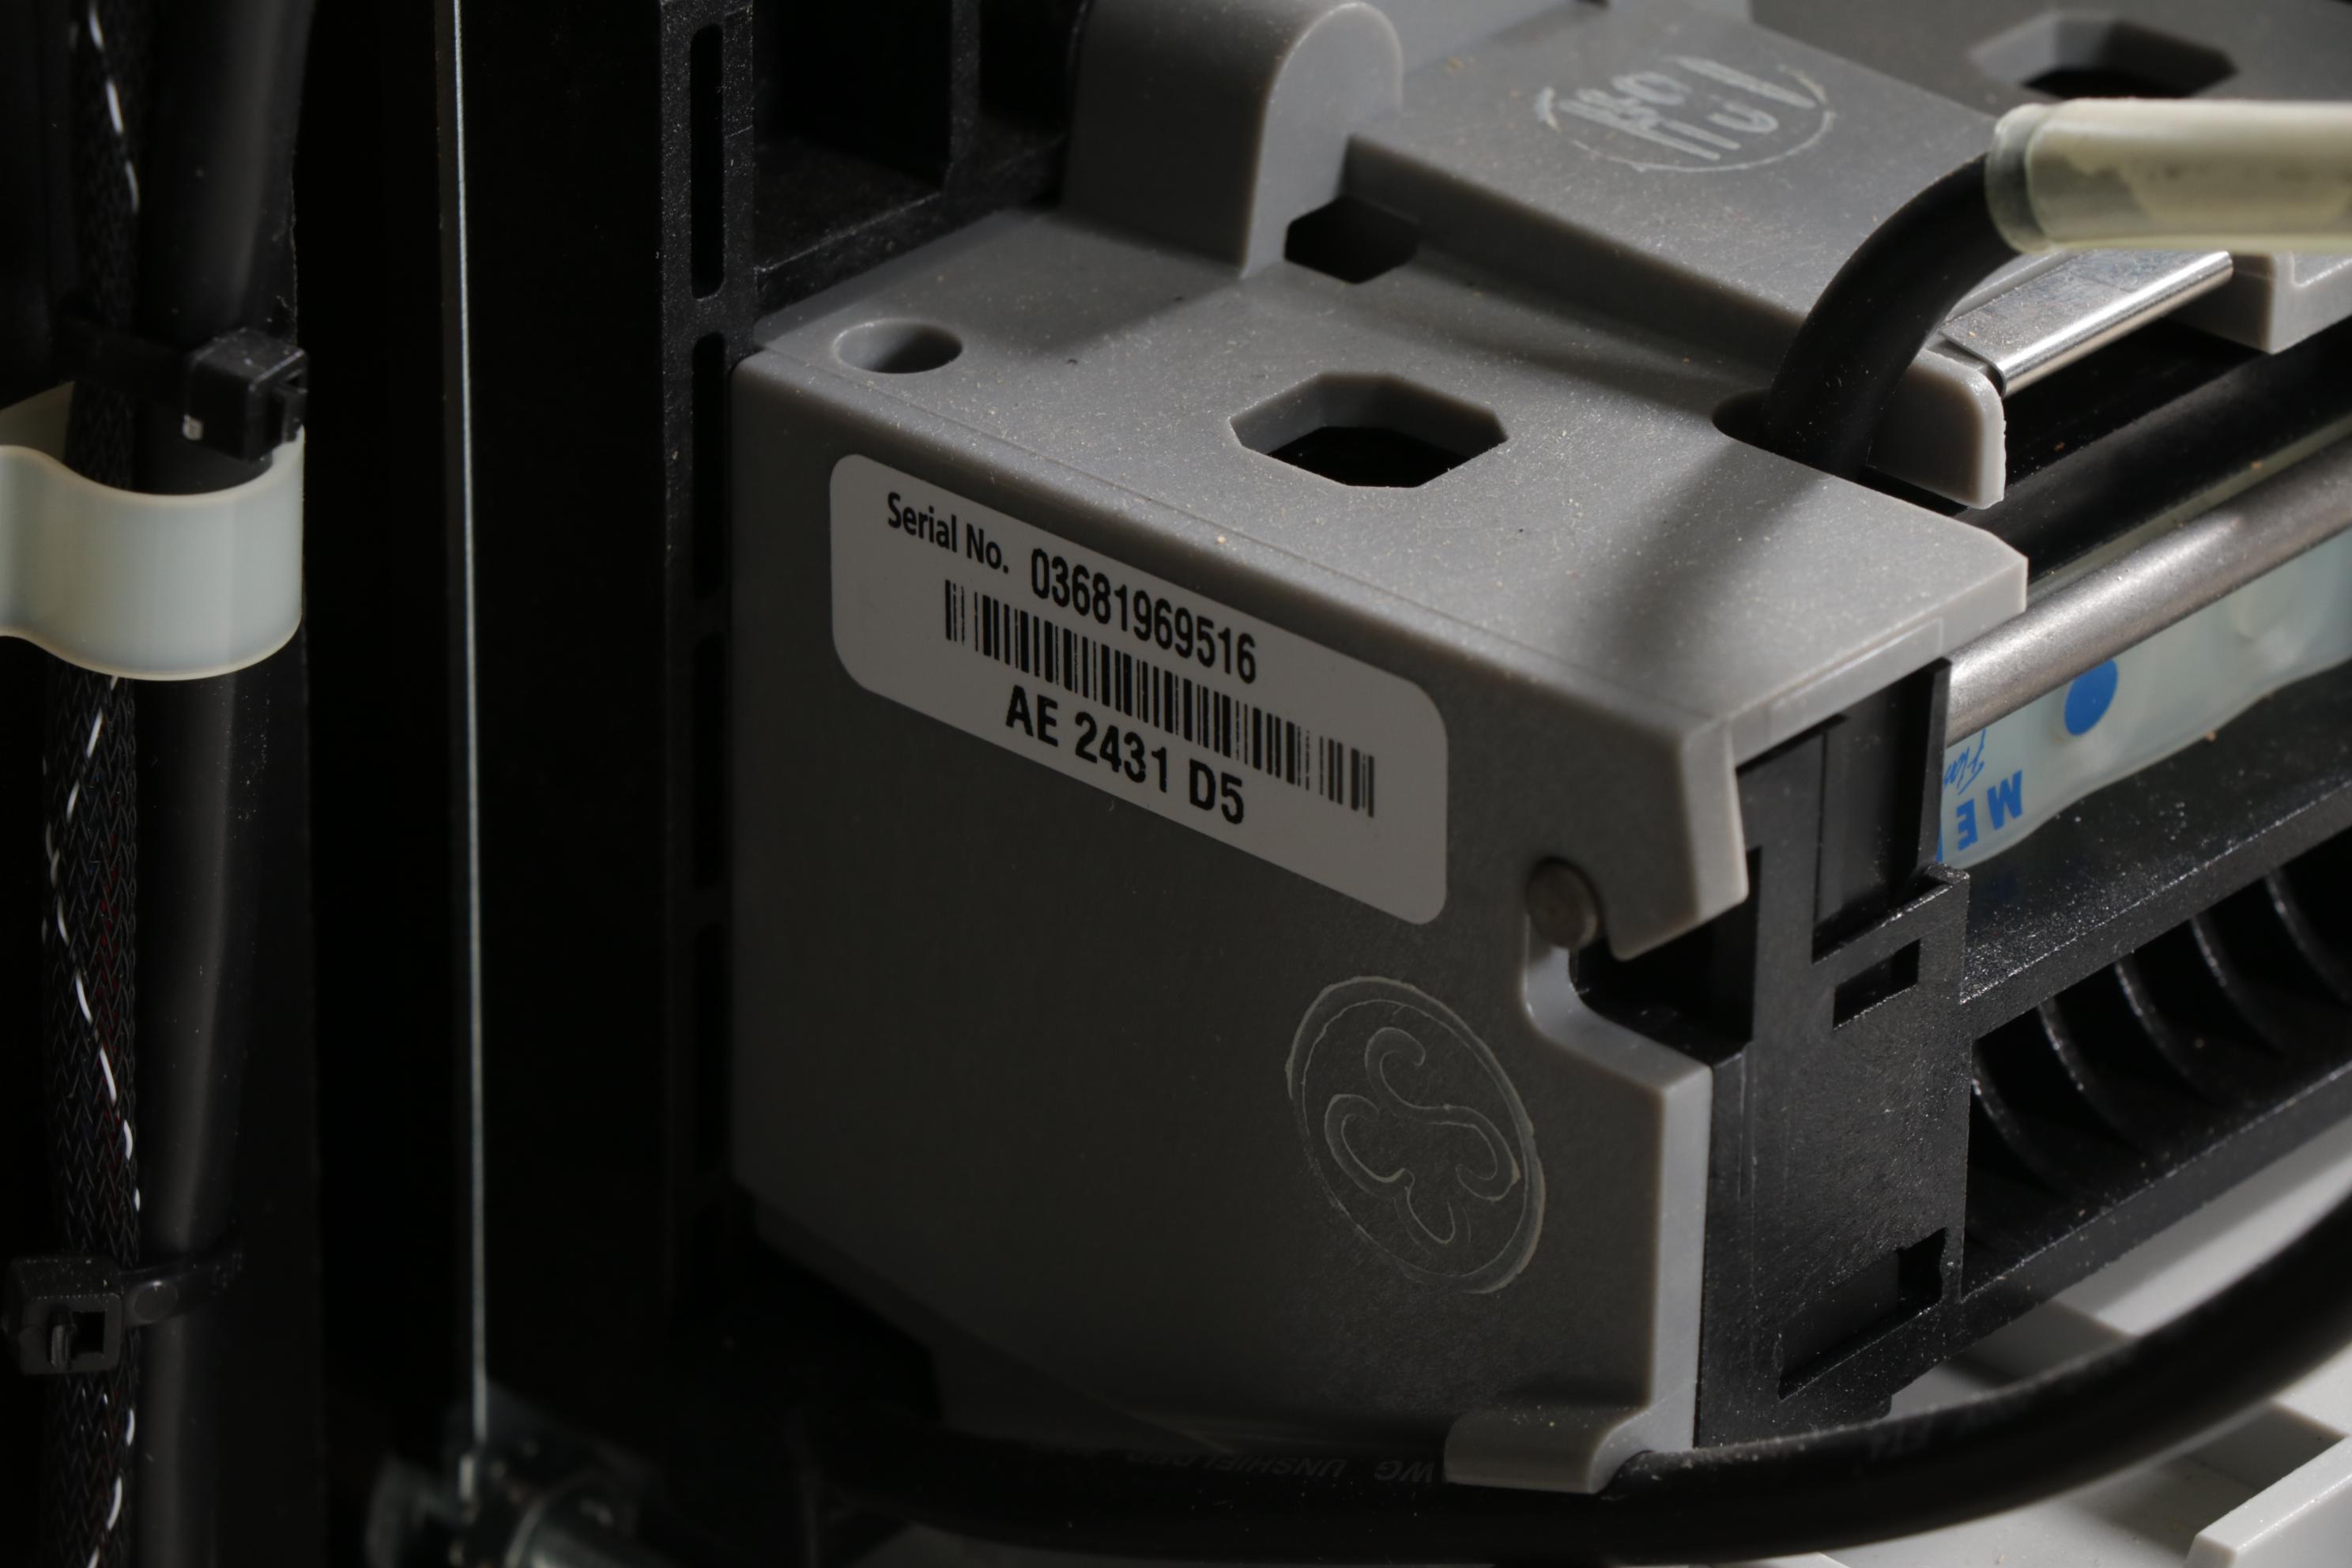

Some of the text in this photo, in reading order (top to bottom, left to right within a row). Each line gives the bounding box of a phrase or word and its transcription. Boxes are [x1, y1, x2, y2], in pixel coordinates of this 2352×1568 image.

[887, 491, 1257, 684] Serial No. 03681969516
[1004, 684, 1245, 825] AE 2431 D5
[1936, 770, 2022, 865] ME
